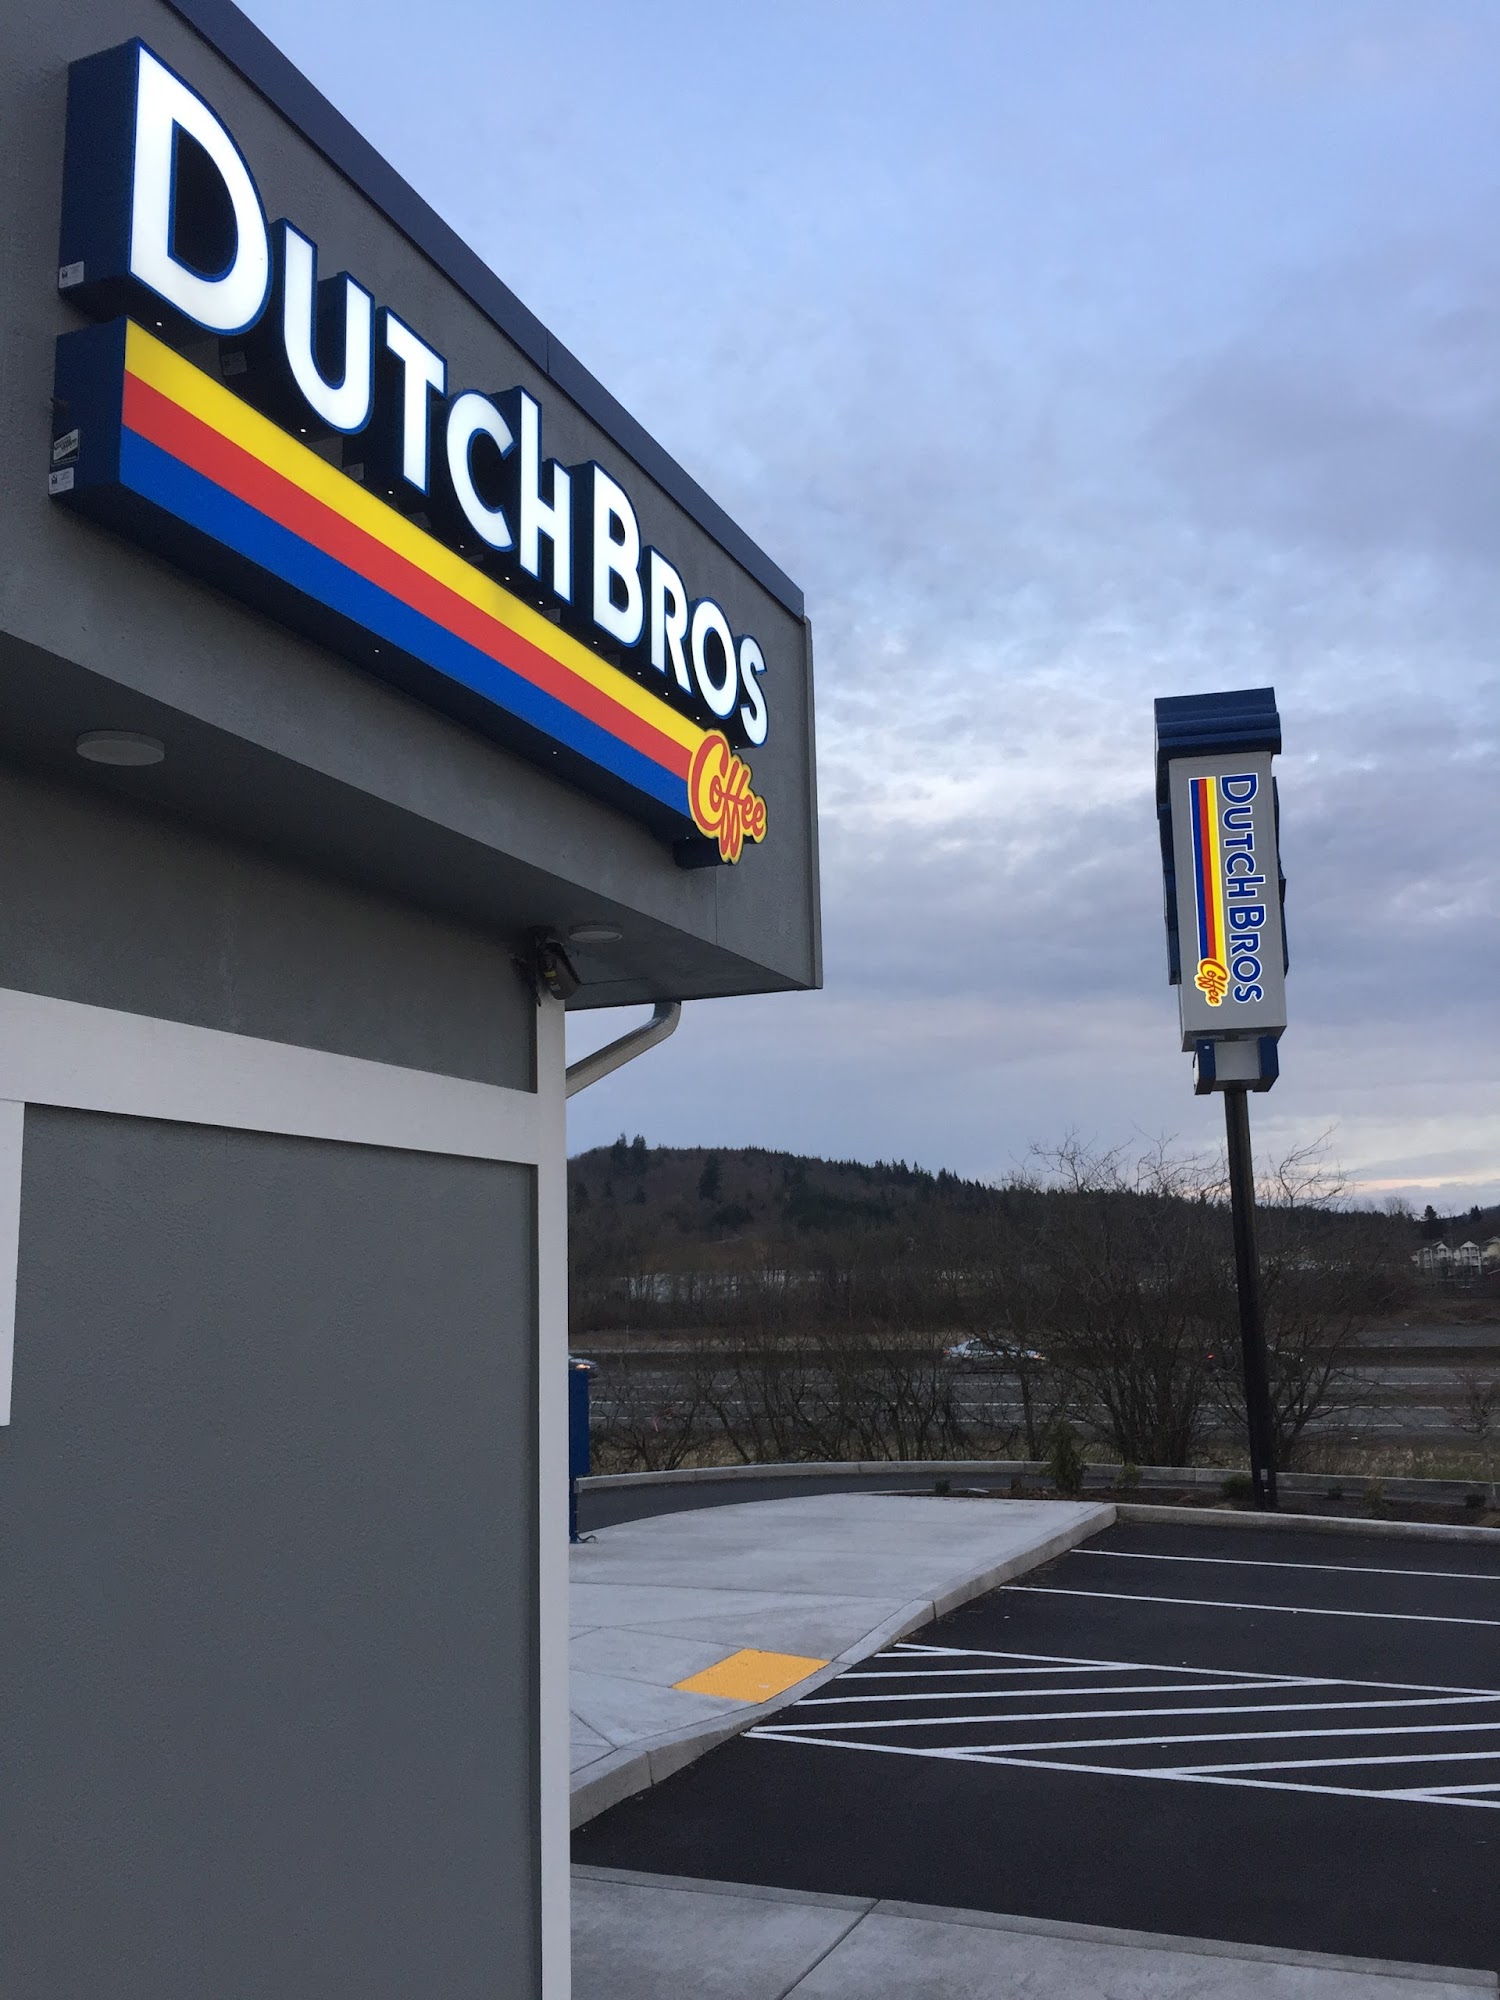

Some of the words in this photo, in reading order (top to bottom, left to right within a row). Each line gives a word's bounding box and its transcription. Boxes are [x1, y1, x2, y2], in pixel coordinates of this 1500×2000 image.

[129, 45, 573, 604] DUTCH
[593, 462, 768, 747] BROS
[690, 733, 766, 862] Coffee
[1221, 773, 1266, 898] DUTCH
[1197, 959, 1229, 1005] Coffee
[1227, 905, 1266, 1003] BROS
